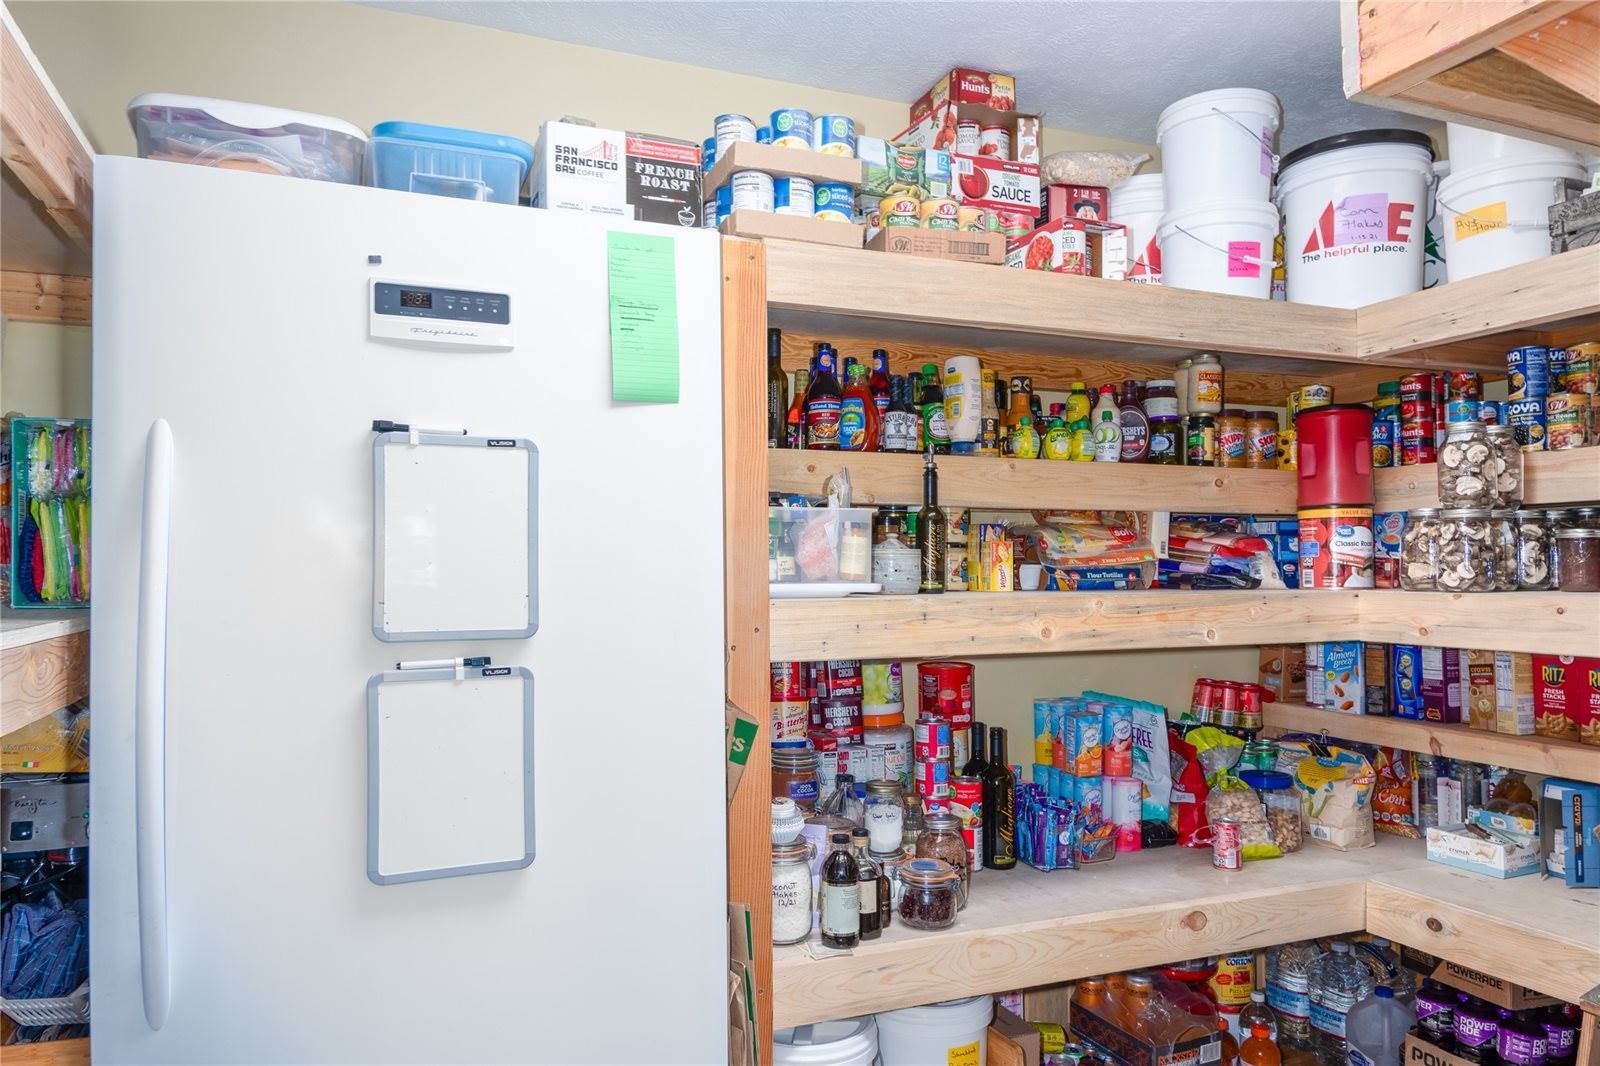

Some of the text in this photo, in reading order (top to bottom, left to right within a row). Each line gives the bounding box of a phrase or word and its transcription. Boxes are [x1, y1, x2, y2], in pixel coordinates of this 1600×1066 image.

[555, 145, 578, 156] SAN
[555, 154, 618, 171] FRANCISCO
[555, 164, 604, 179] BAY COFFEE
[634, 162, 695, 181] FRENCH
[640, 174, 690, 192] ROAST
[992, 185, 1031, 203] SAUCE
[1302, 243, 1408, 264] The helpful place.
[410, 326, 478, 338] Frigidaire
[1401, 382, 1421, 391] unts
[1121, 426, 1145, 436] RSHEY'S
[1326, 648, 1356, 665] Almond
[1333, 657, 1354, 670] Breeze
[1541, 664, 1565, 683] RITZ
[1588, 669, 1600, 687] RI
[1542, 693, 1566, 701] STACKS
[825, 705, 859, 718] HERSHEY'S
[1131, 726, 1154, 749] FREE
[1446, 962, 1504, 990] POWERADE
[1459, 1015, 1498, 1031] POWER
